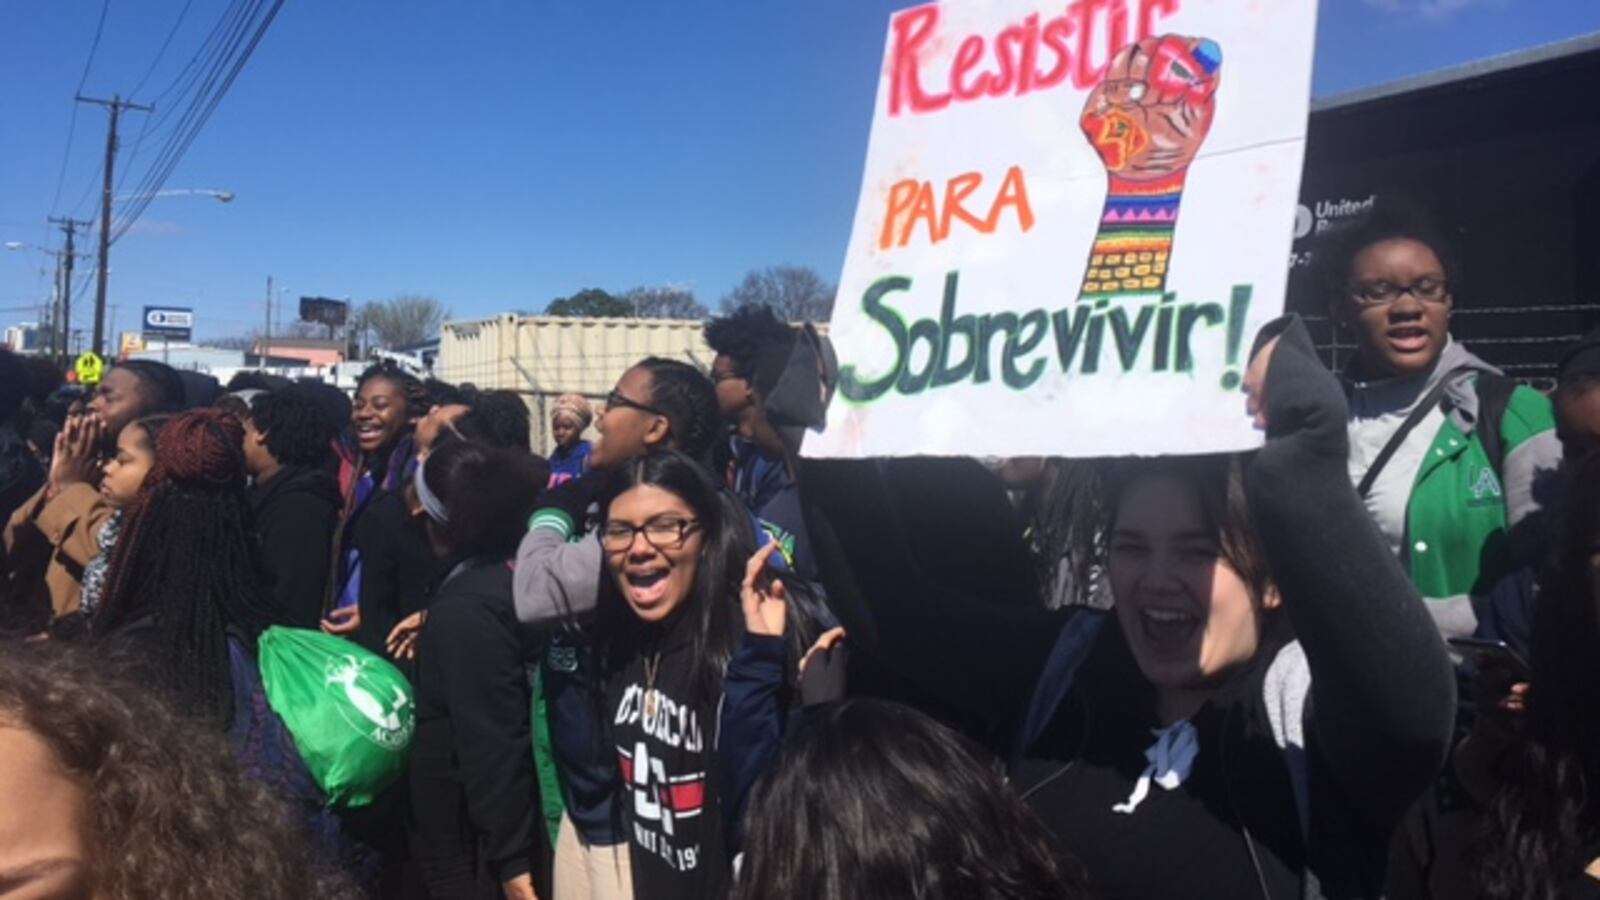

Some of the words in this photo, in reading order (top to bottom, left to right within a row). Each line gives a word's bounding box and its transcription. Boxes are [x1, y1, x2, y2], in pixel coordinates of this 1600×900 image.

[888, 0, 1180, 117] Resistir
[879, 165, 1036, 251] PARA
[1315, 194, 1377, 218] United
[837, 270, 1254, 407] Sobrevivir!
